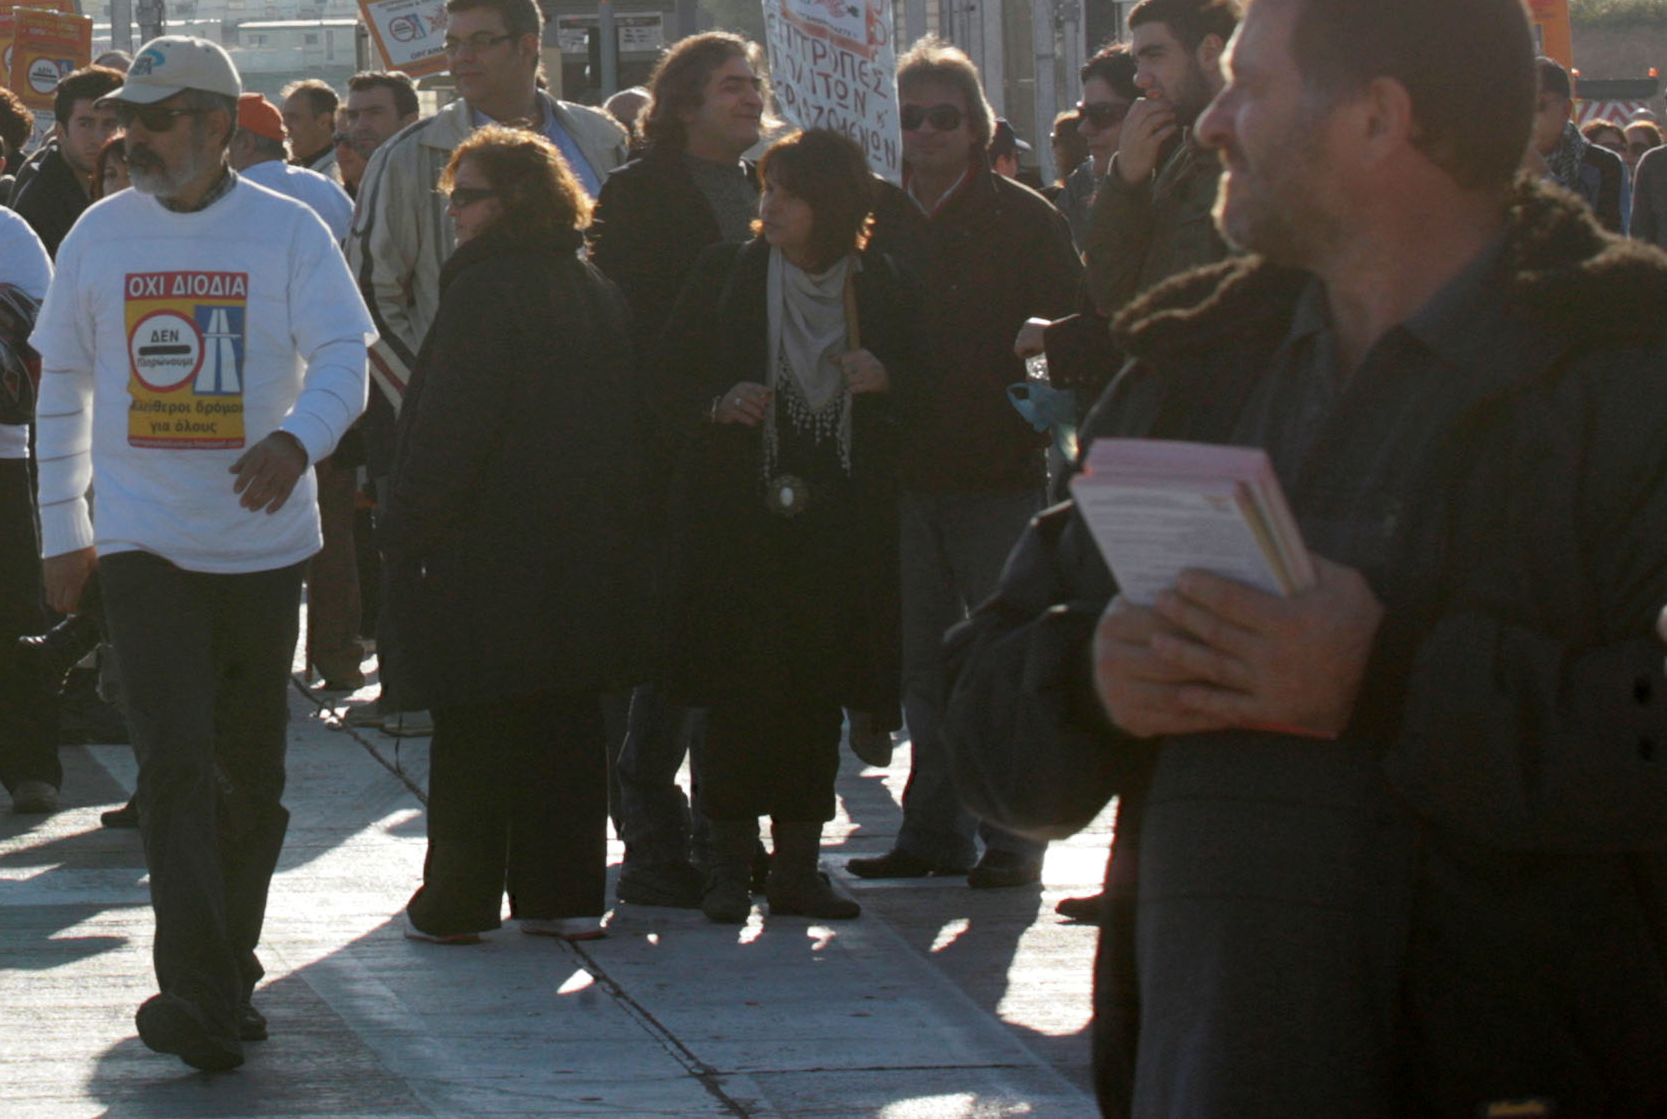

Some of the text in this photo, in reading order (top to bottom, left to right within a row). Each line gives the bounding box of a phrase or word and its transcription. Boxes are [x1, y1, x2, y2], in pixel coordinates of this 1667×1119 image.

[129, 274, 246, 298] ΟΧΙ ΔΙΟΔΙΑ
[150, 329, 179, 343] ΔΕΝ
[150, 419, 217, 434] για όλους
